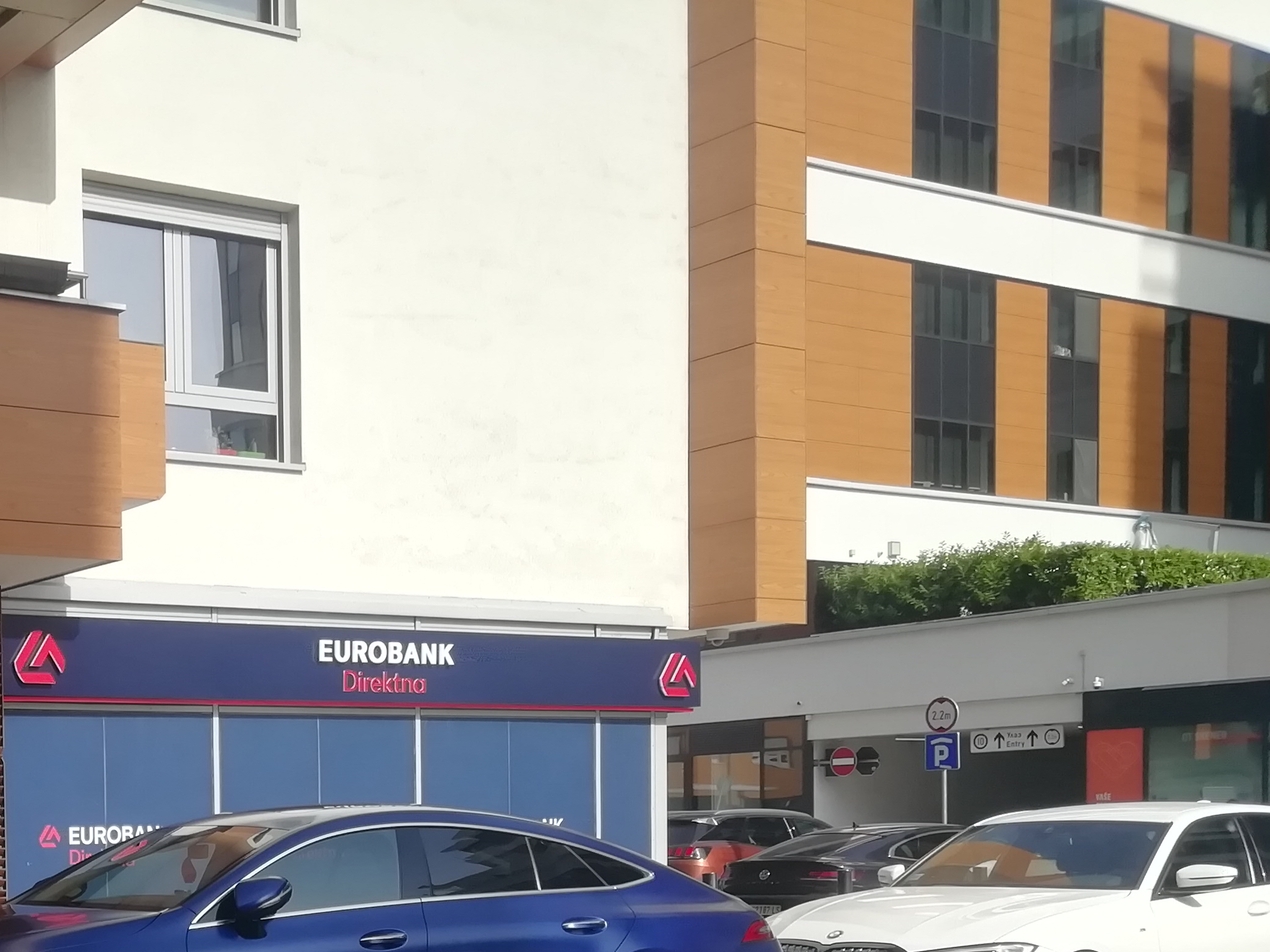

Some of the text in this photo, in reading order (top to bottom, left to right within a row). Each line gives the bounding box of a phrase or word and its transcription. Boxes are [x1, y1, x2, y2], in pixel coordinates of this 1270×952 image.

[318, 639, 455, 666] EUROBANK
[342, 669, 427, 694] Direktna
[934, 744, 950, 767] P
[1006, 740, 1025, 748] Entry
